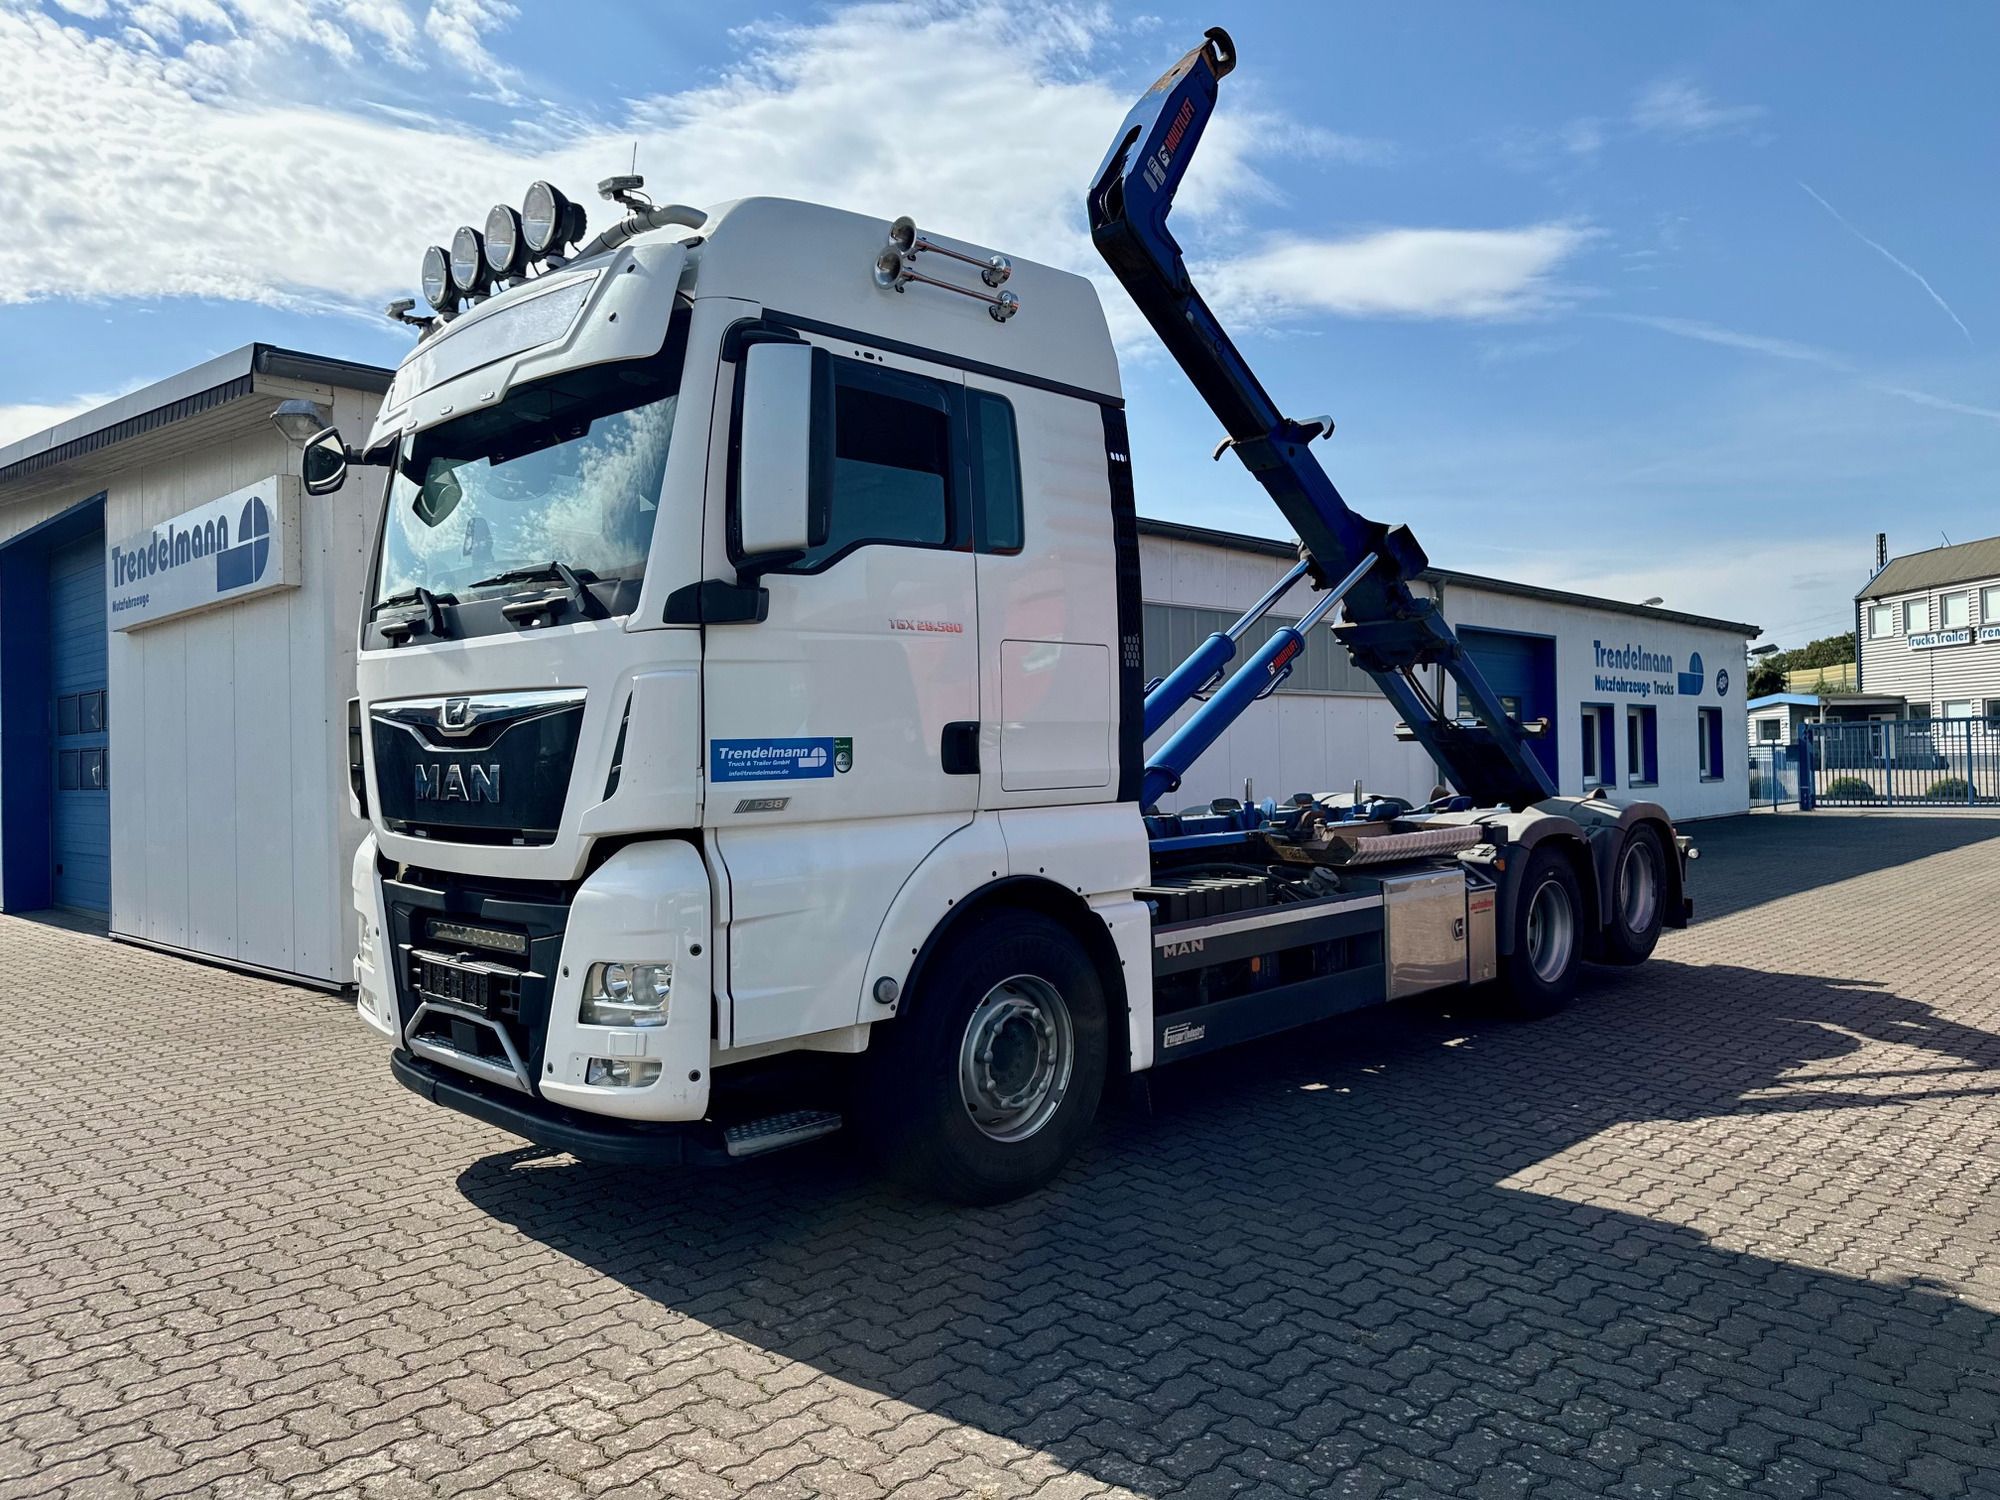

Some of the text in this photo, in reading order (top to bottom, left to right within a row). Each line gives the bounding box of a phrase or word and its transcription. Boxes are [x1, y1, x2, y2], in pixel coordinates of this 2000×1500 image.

[1164, 97, 1195, 153] MULTILIFT
[111, 514, 229, 588] Trendelmann
[112, 593, 150, 613] Nutzfahrzeuge
[888, 619, 915, 630] TGX
[1907, 631, 1970, 648] Trucks Trailer
[1593, 639, 1673, 674] Trendelmann
[1594, 674, 1674, 698] Nutzfahrzeuge Trucks
[719, 746, 808, 760] Trendelmann
[415, 764, 500, 803] MAN
[1163, 938, 1204, 959] MAN
